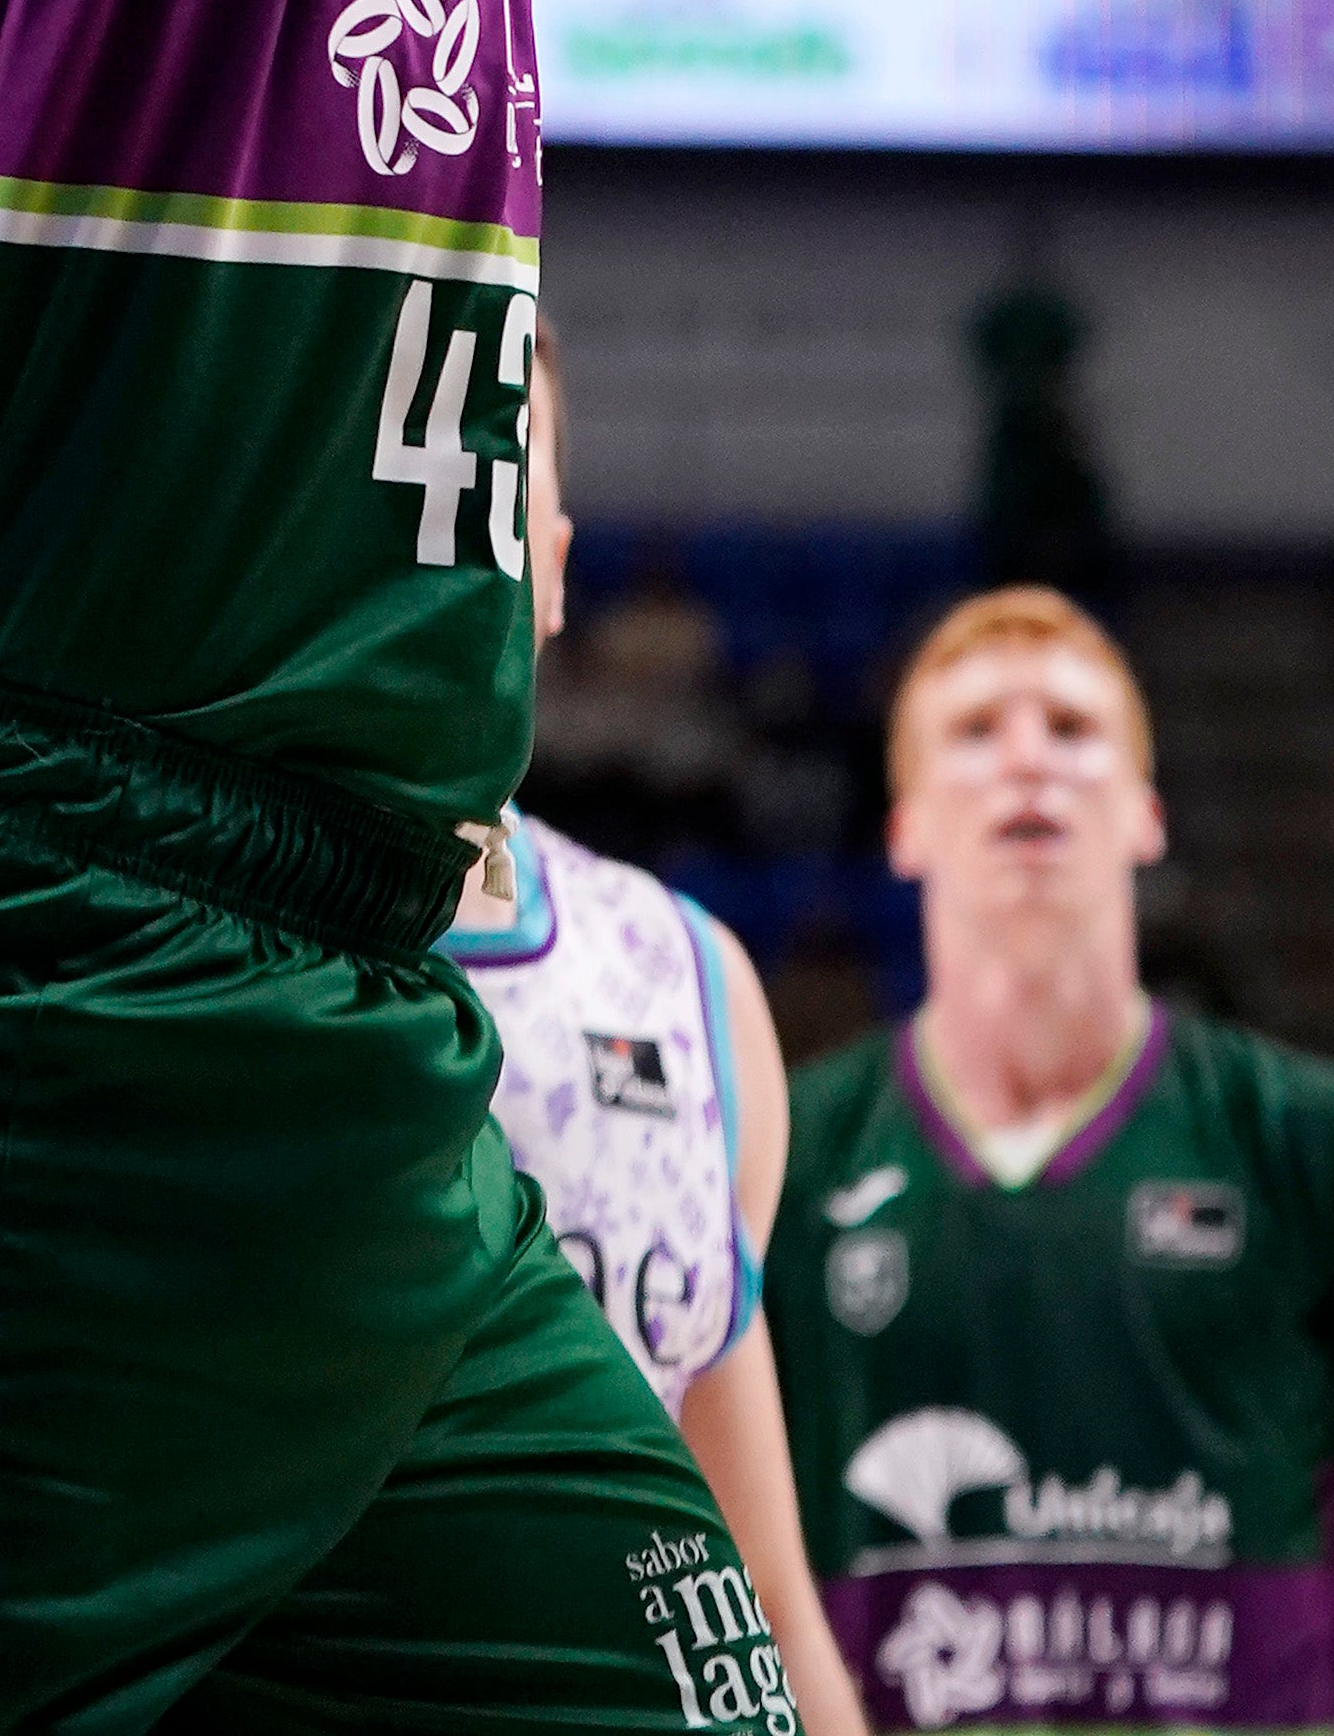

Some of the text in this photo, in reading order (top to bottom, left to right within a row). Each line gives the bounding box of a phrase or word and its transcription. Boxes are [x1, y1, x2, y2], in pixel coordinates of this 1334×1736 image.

[625, 1530, 710, 1582] sabor
[639, 1565, 771, 1651] a m
[654, 1628, 797, 1736] lag
